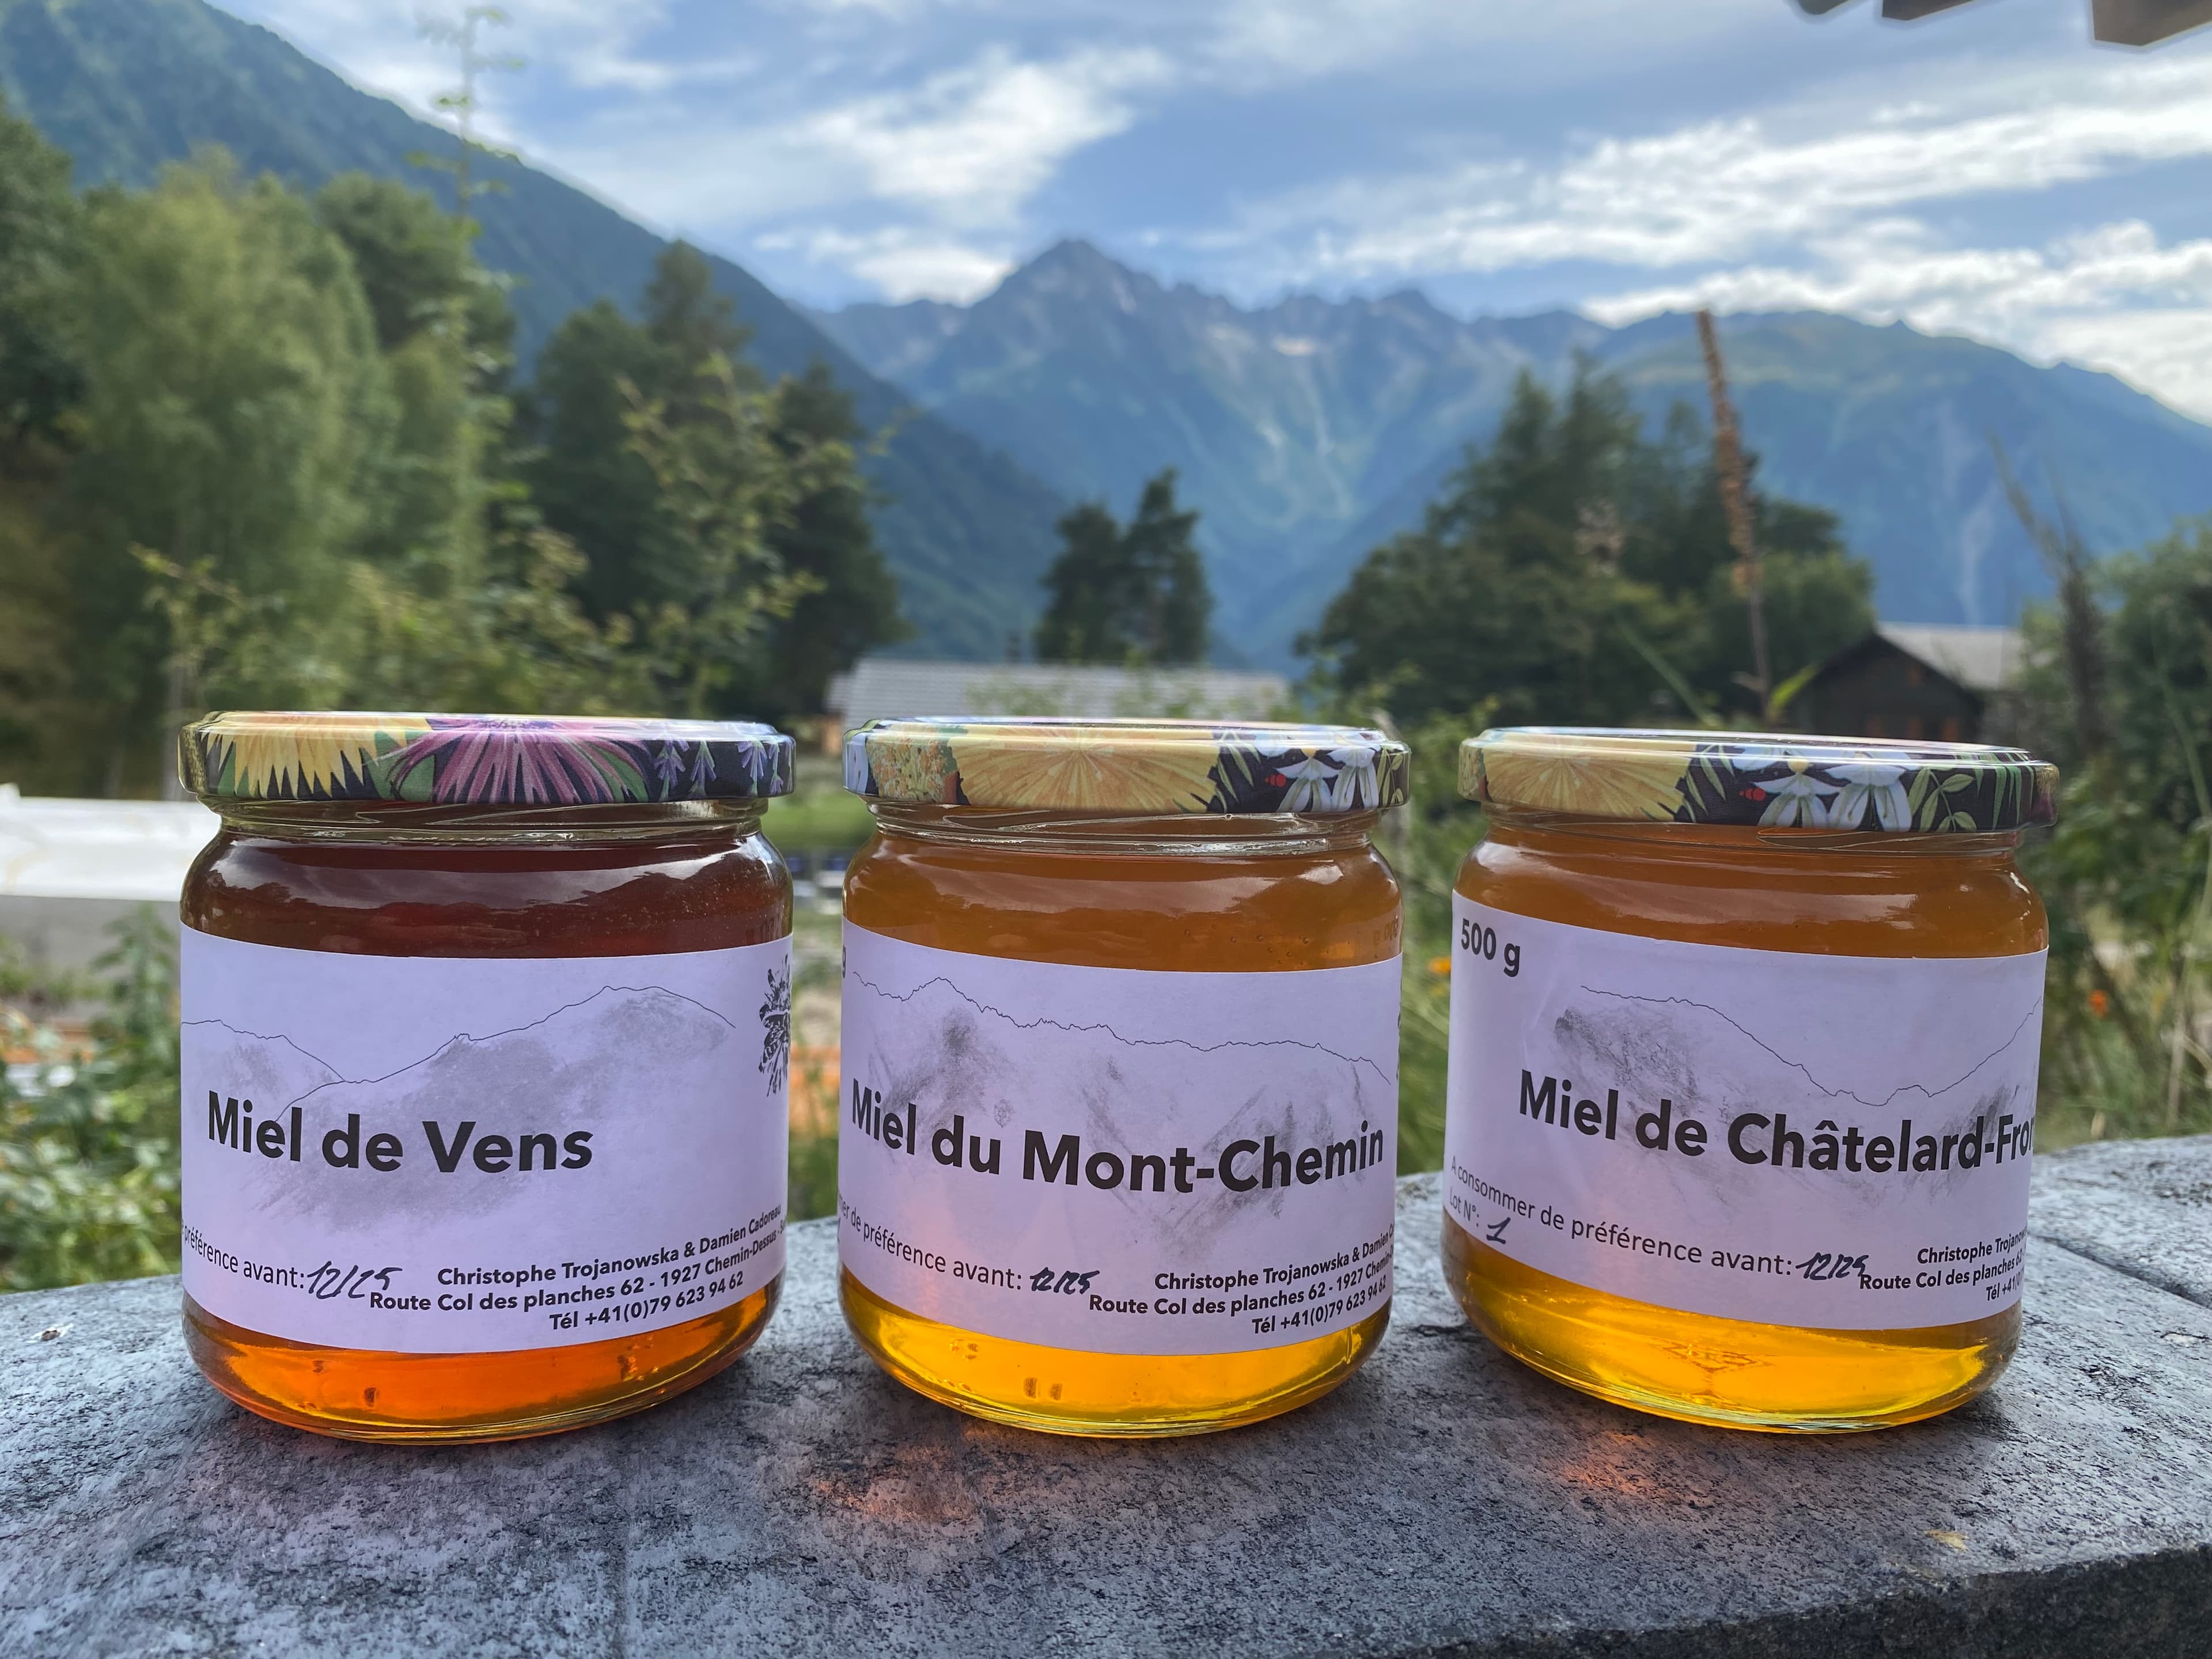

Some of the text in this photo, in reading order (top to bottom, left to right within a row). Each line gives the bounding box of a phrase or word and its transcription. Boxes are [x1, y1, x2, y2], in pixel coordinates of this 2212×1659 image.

[1461, 918, 1520, 978] 500 g
[209, 1090, 593, 1173] Miel de Vens
[851, 1078, 1383, 1194] Miel du Mont-Chemin
[1519, 1070, 1618, 1141] Miel
[1637, 1099, 1708, 1156] de
[1450, 1186, 1461, 1214] Lot
[1452, 1156, 1792, 1275] A consommer de préférence avant:
[184, 1225, 238, 1272] préférence
[243, 1261, 304, 1289] avant:
[438, 1265, 556, 1287] Christophe
[562, 1247, 679, 1280] Trojanowska
[684, 1241, 695, 1258] &
[699, 1226, 746, 1254] Damien
[749, 1203, 782, 1234] Cadoreau
[851, 1207, 861, 1232] de
[863, 1221, 946, 1272] préférence
[953, 1261, 1021, 1290] avant:
[1486, 1217, 1511, 1245] 1
[1918, 1241, 1992, 1264] Christophe
[370, 1292, 431, 1310] Route
[438, 1293, 472, 1311] Col
[479, 1293, 517, 1310] des
[524, 1284, 615, 1312] planches
[620, 1277, 644, 1296] 62
[661, 1263, 701, 1287] 1927
[705, 1230, 777, 1275] Chemin-Dessus
[1155, 1232, 1389, 1292] Christophe Trojanowska & Damien
[1860, 1274, 1911, 1290] Route
[1916, 1271, 1941, 1288] Col
[1945, 1269, 1969, 1285] des
[1973, 1257, 2015, 1286] planches
[1986, 1283, 1999, 1301] Tél
[550, 1271, 744, 1330] Tél +41(0)79 623 94 62
[1090, 1294, 1148, 1314] Route
[1154, 1298, 1186, 1315] Col
[1192, 1297, 1225, 1314] des
[1230, 1290, 1304, 1317] planches
[1308, 1282, 1325, 1300] 62
[1337, 1268, 1363, 1291] 1927
[1252, 1275, 1386, 1334] Tél +41(0)79 623 94 62
